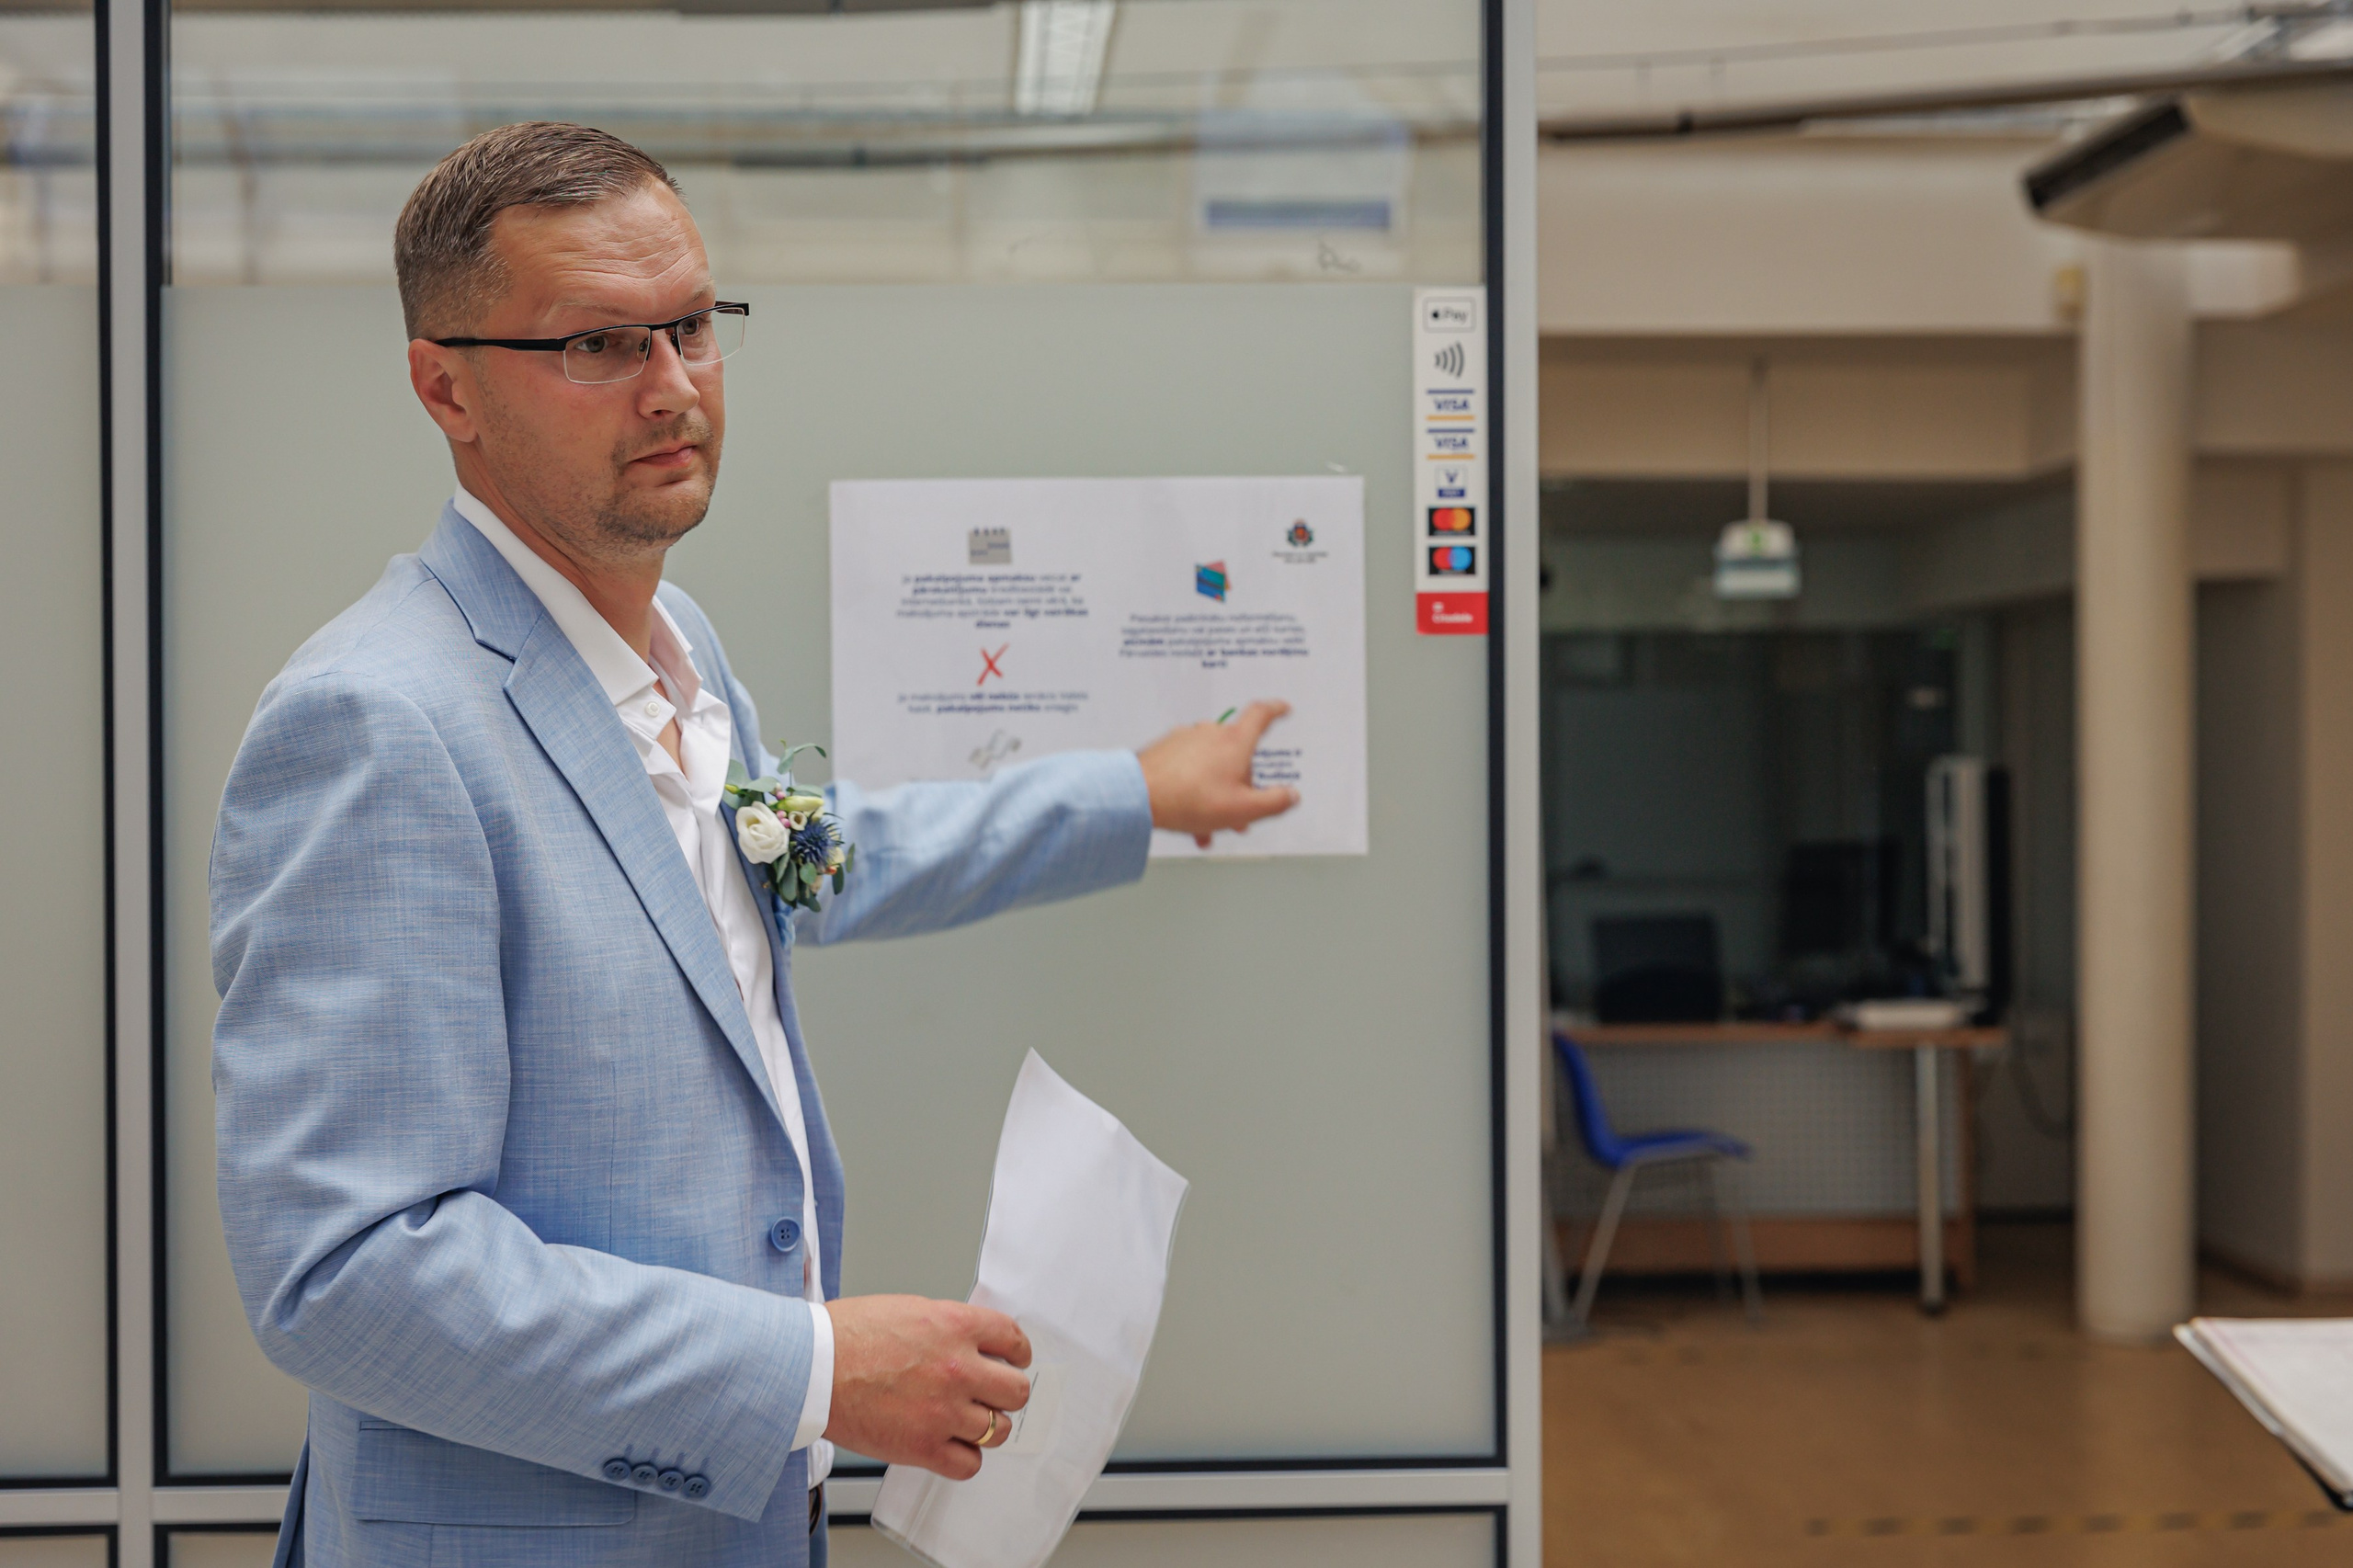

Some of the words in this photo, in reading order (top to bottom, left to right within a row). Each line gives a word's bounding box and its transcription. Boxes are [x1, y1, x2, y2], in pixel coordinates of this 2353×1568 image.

[1444, 309, 1466, 323] Pay
[1435, 400, 1469, 411] VISA
[1435, 438, 1469, 449] VISA
